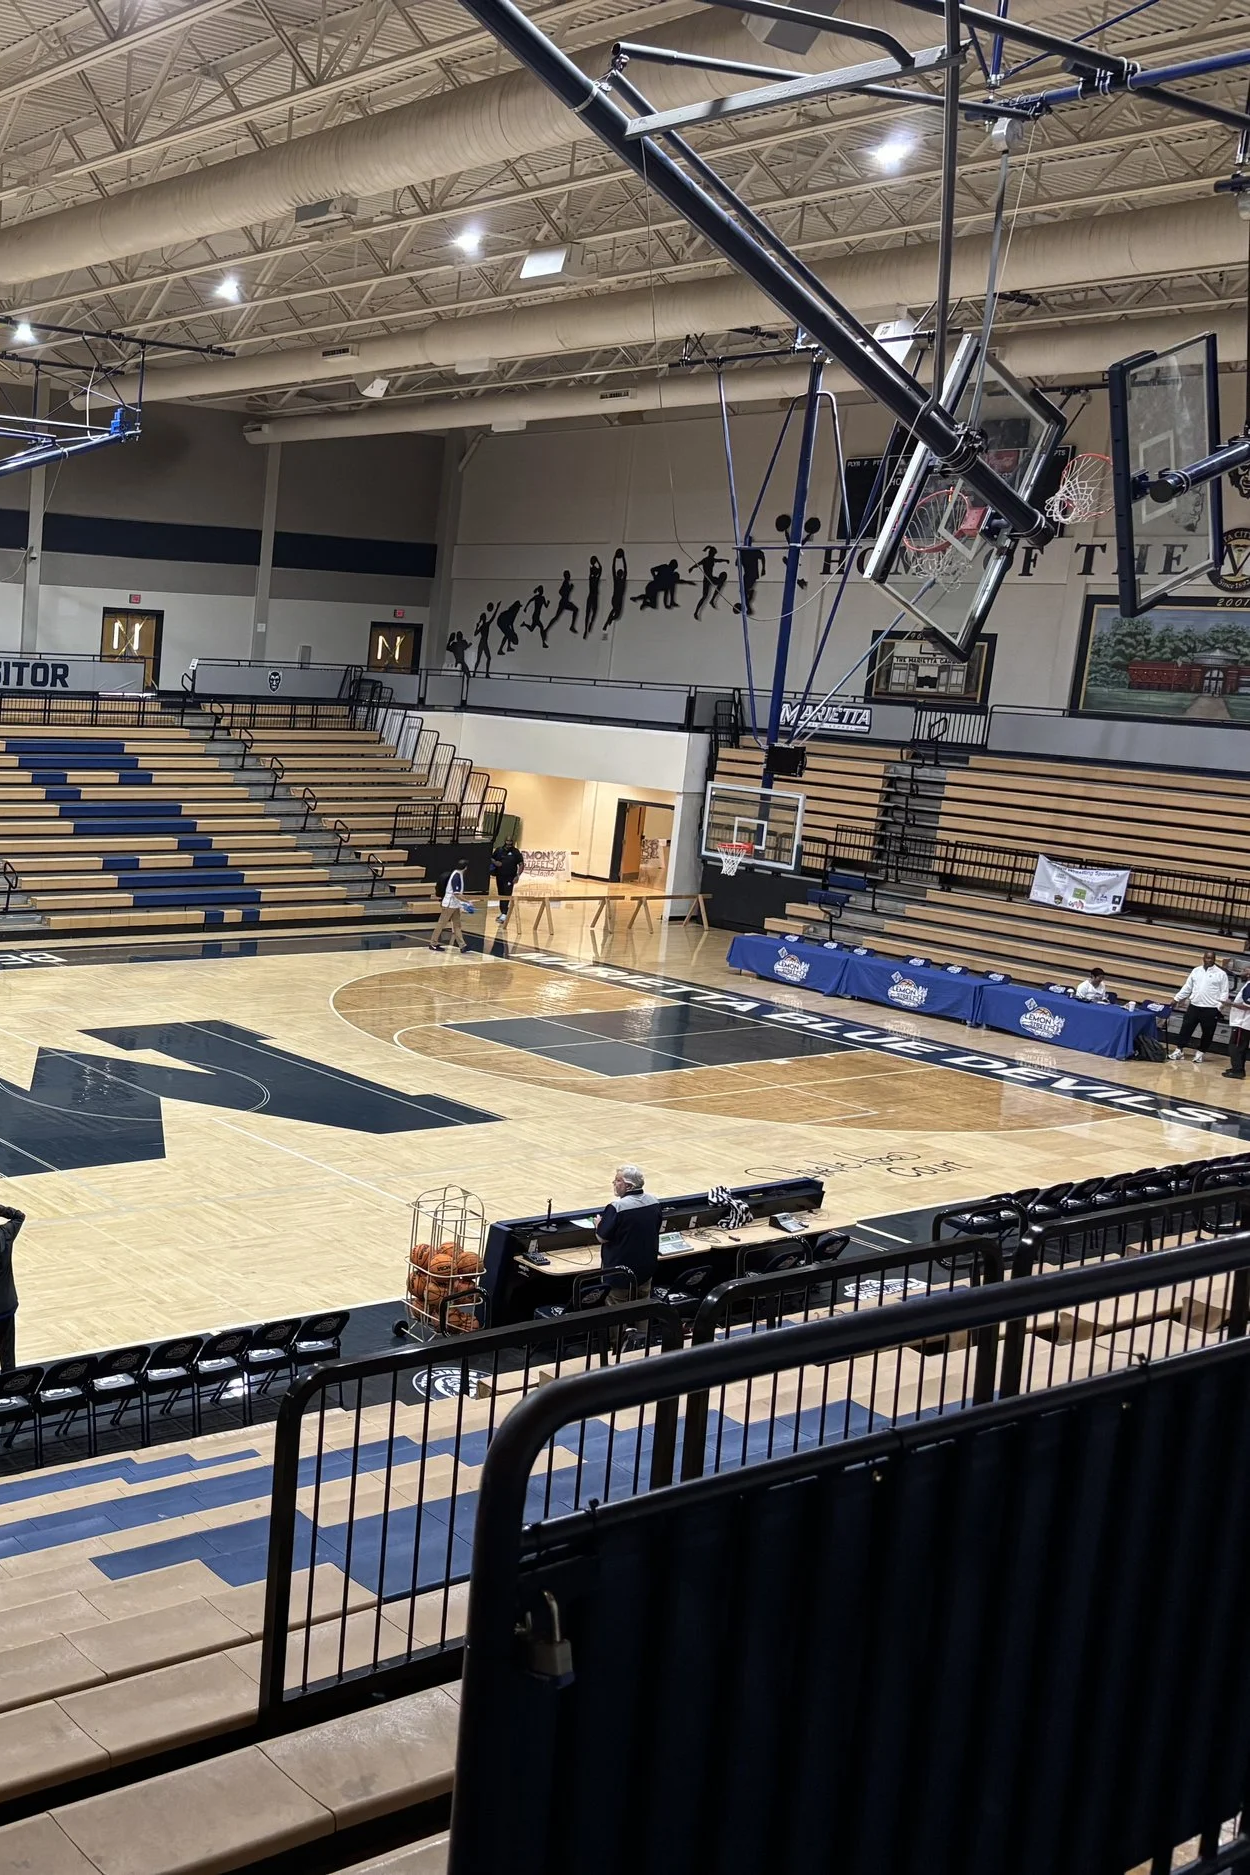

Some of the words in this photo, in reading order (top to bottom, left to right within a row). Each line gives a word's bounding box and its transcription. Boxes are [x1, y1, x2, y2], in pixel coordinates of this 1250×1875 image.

[1074, 543, 1190, 576] THE
[779, 703, 871, 726] MARIETTA
[892, 985, 916, 995] LEMON
[1024, 1013, 1051, 1025] LEMON
[511, 951, 762, 1013] MARIETTA
[761, 1011, 950, 1057] BLUE
[939, 1055, 1230, 1124] DEVILS
[886, 1159, 973, 1178] Court
